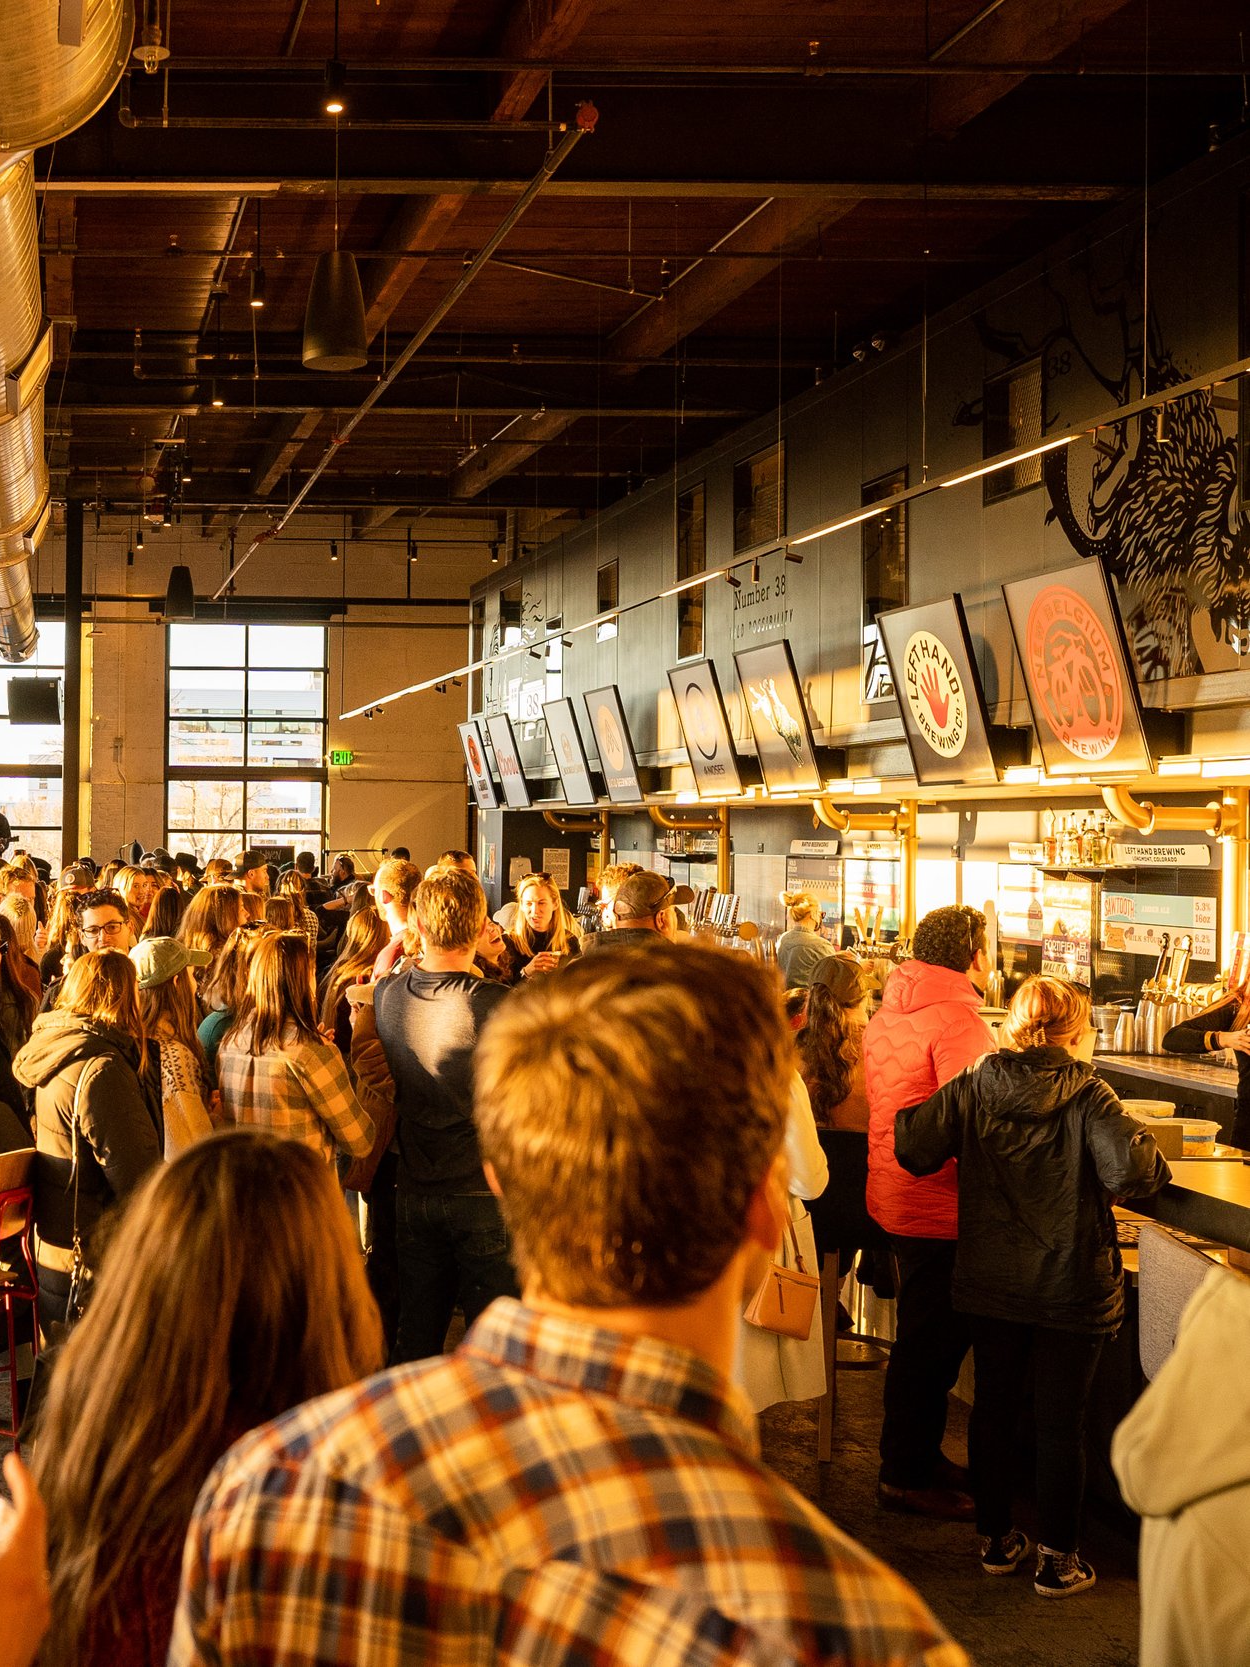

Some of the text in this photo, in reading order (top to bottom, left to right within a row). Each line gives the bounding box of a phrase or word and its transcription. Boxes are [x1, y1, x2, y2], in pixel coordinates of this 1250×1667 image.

[734, 574, 786, 610] Number 38
[1044, 599, 1111, 672] BELGIUM
[918, 711, 960, 750] BREWING
[1062, 727, 1116, 756] BREWING
[333, 751, 351, 765] EXIT
[1124, 846, 1186, 856] LEFT HAND BREWING
[1104, 896, 1135, 920] SAWTOOTH
[1194, 902, 1211, 911] 5.3%
[1195, 914, 1211, 924] 16oz
[1044, 938, 1076, 953] FORTIFIED
[1194, 934, 1211, 943] 6.2%
[1194, 946, 1211, 956] 12oz
